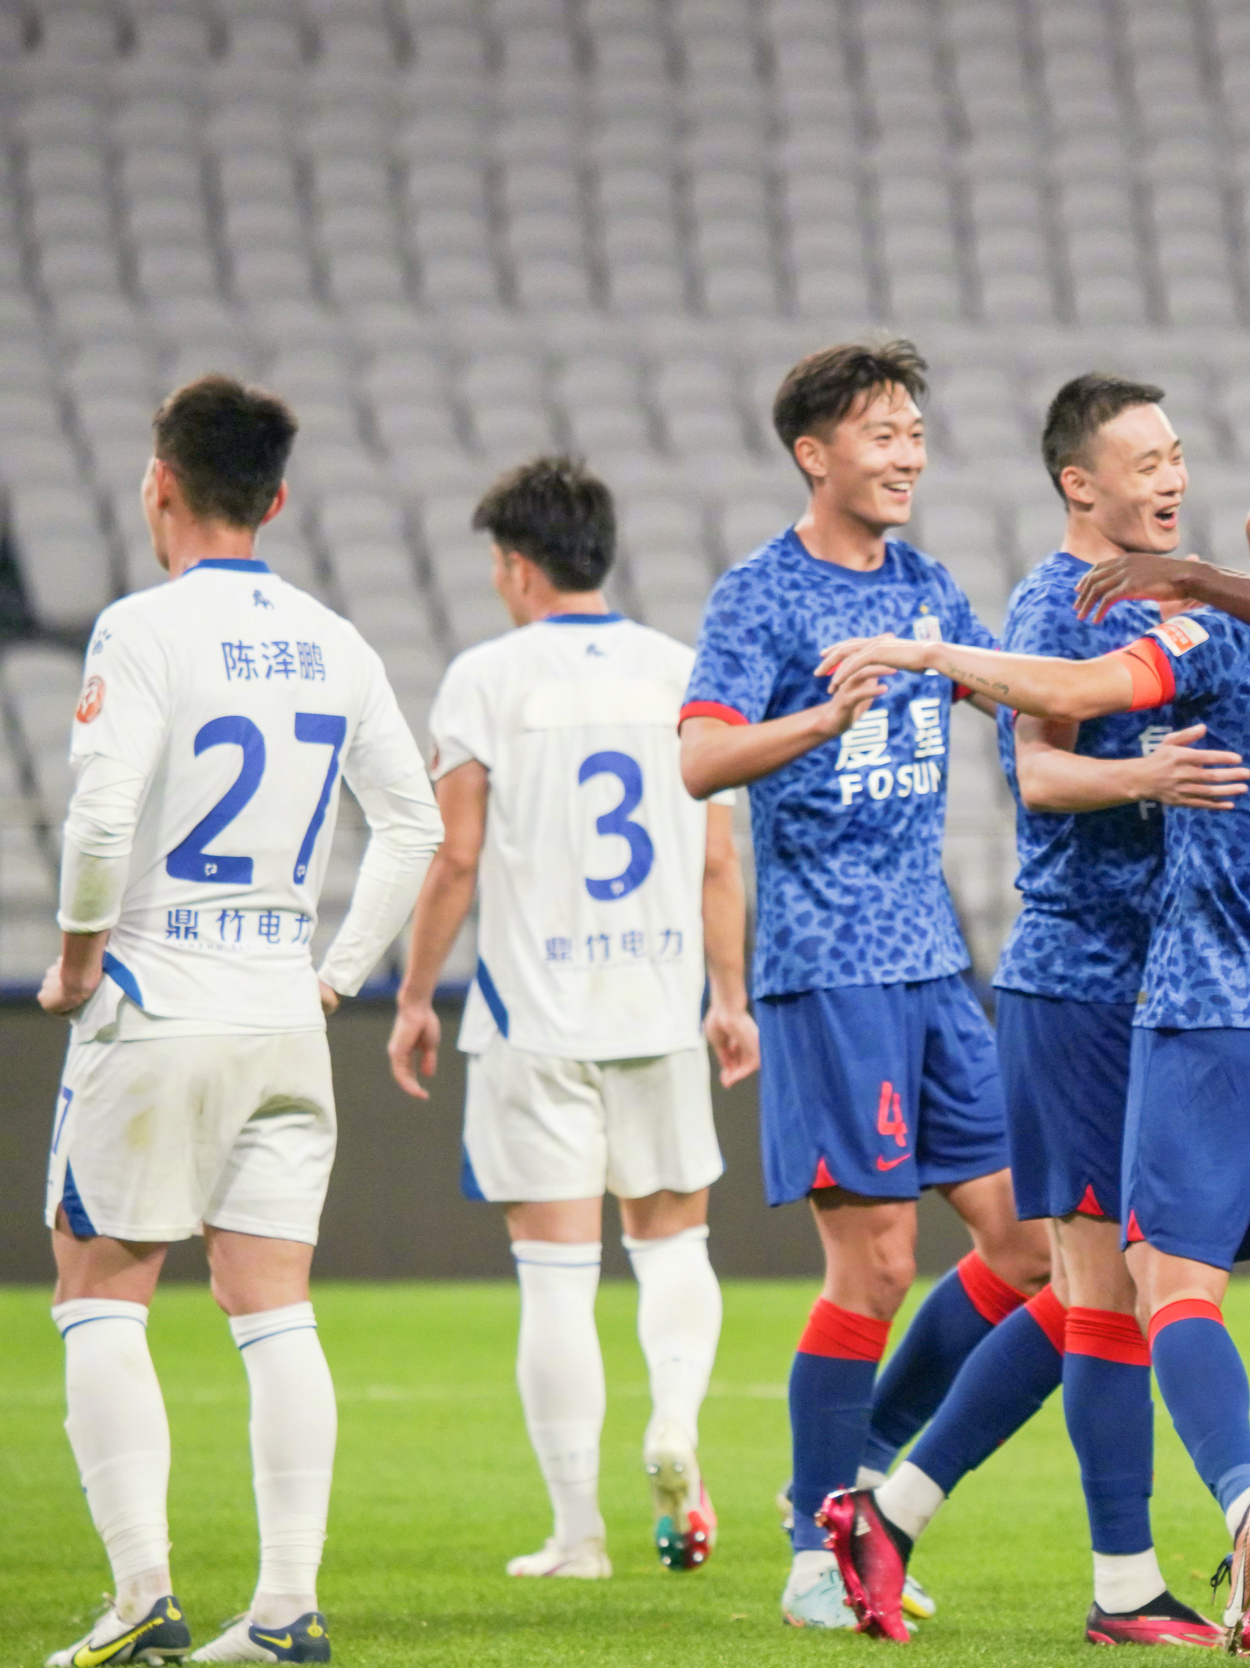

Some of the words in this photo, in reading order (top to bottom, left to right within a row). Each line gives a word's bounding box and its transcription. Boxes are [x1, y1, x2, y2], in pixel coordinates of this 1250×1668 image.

[220, 640, 326, 681] 陈泽鹏
[165, 712, 347, 885] 27
[577, 751, 654, 901] 3
[165, 908, 312, 945] 鼎竹电力
[544, 929, 684, 963] 鼎竹电力
[877, 1081, 908, 1147] 4
